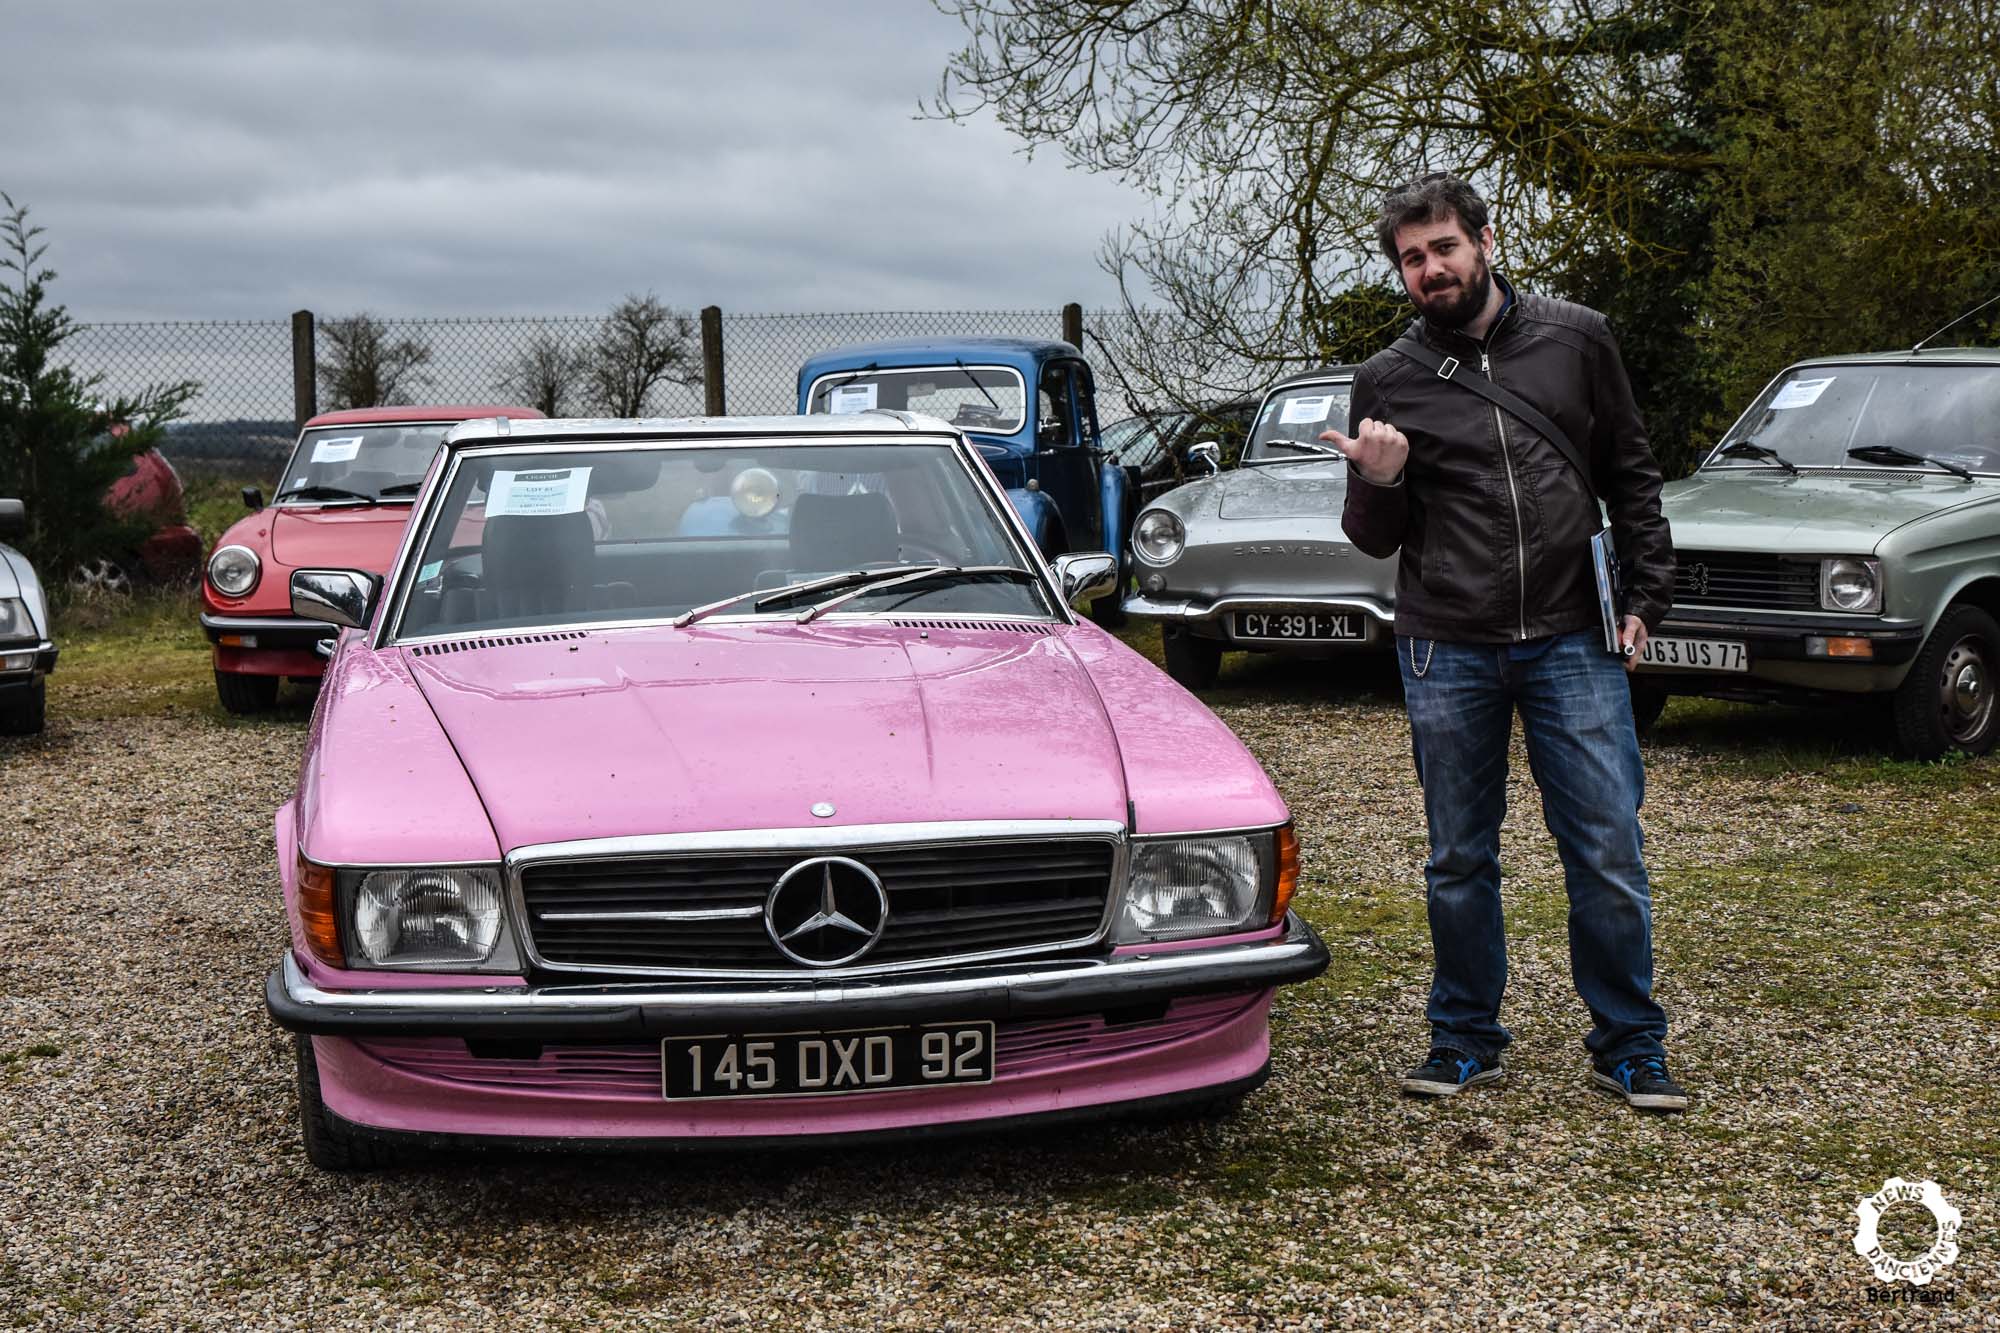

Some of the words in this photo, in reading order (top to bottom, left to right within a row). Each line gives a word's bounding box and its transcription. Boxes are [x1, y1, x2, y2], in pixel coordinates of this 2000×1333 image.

[1686, 642, 1711, 666] US
[1718, 644, 1741, 668] 77
[687, 1042, 776, 1092] 145
[921, 1030, 983, 1079] 92
